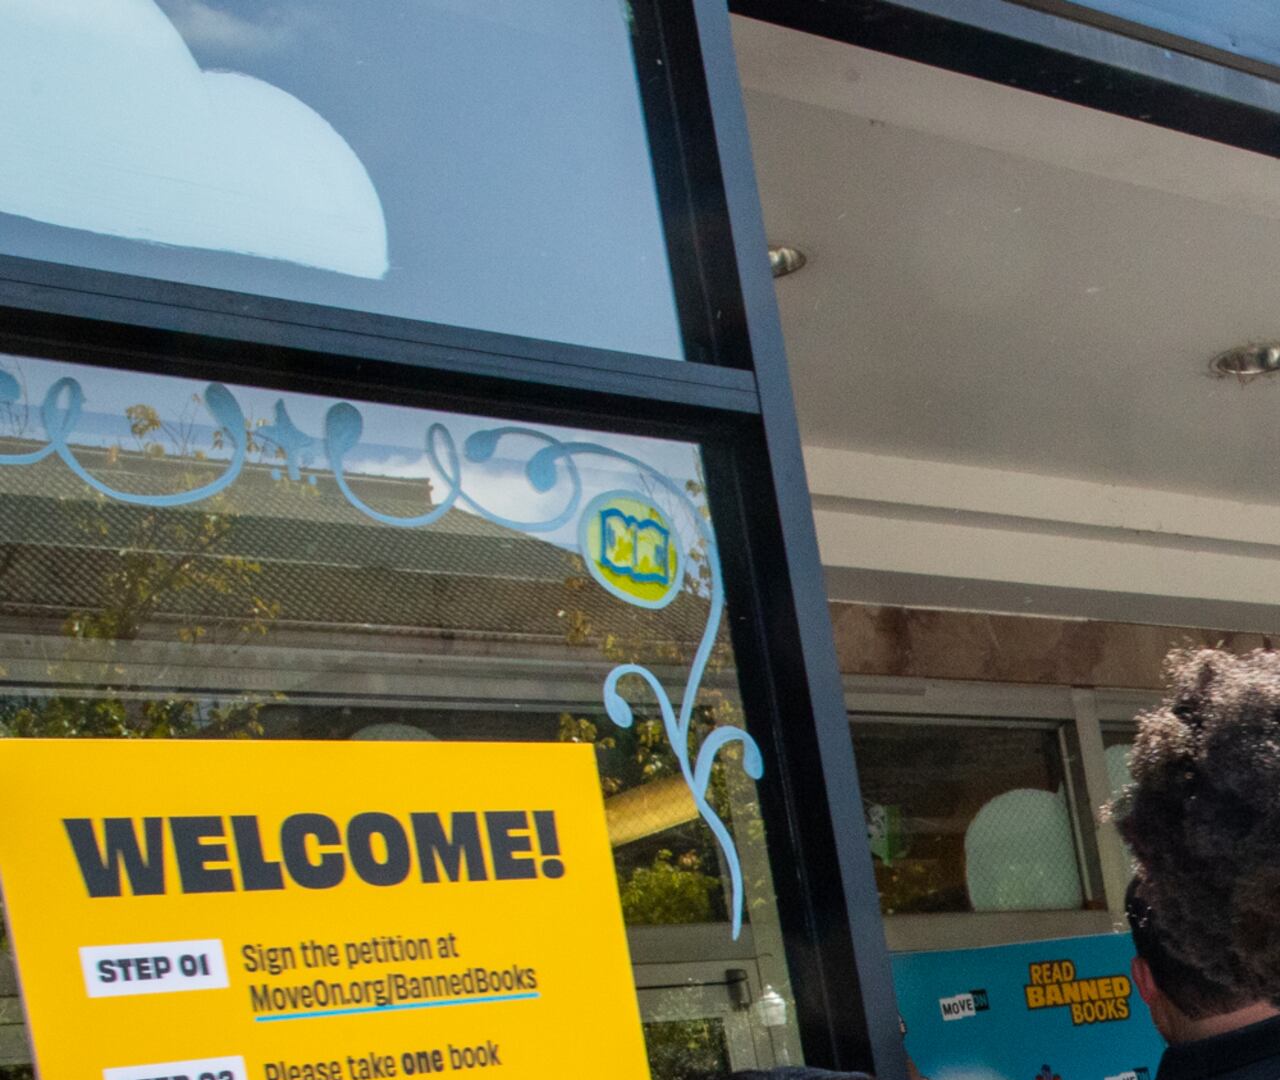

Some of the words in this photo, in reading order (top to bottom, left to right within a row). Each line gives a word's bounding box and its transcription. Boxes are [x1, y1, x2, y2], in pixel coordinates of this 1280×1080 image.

[62, 809, 566, 898] WELCOME!
[97, 955, 171, 984] STEP
[179, 953, 211, 977] 01
[242, 944, 297, 976] Sign
[300, 940, 340, 968] the
[345, 935, 433, 969] petition
[437, 933, 459, 959] at
[1031, 961, 1075, 983] READ
[249, 964, 538, 1012] MoveOn.org/BannedBooks
[1027, 977, 1131, 1008] BANNED
[1072, 1000, 1129, 1025] BOOKS
[347, 1052, 397, 1080] take
[402, 1048, 444, 1075] one
[448, 1040, 502, 1070] book
